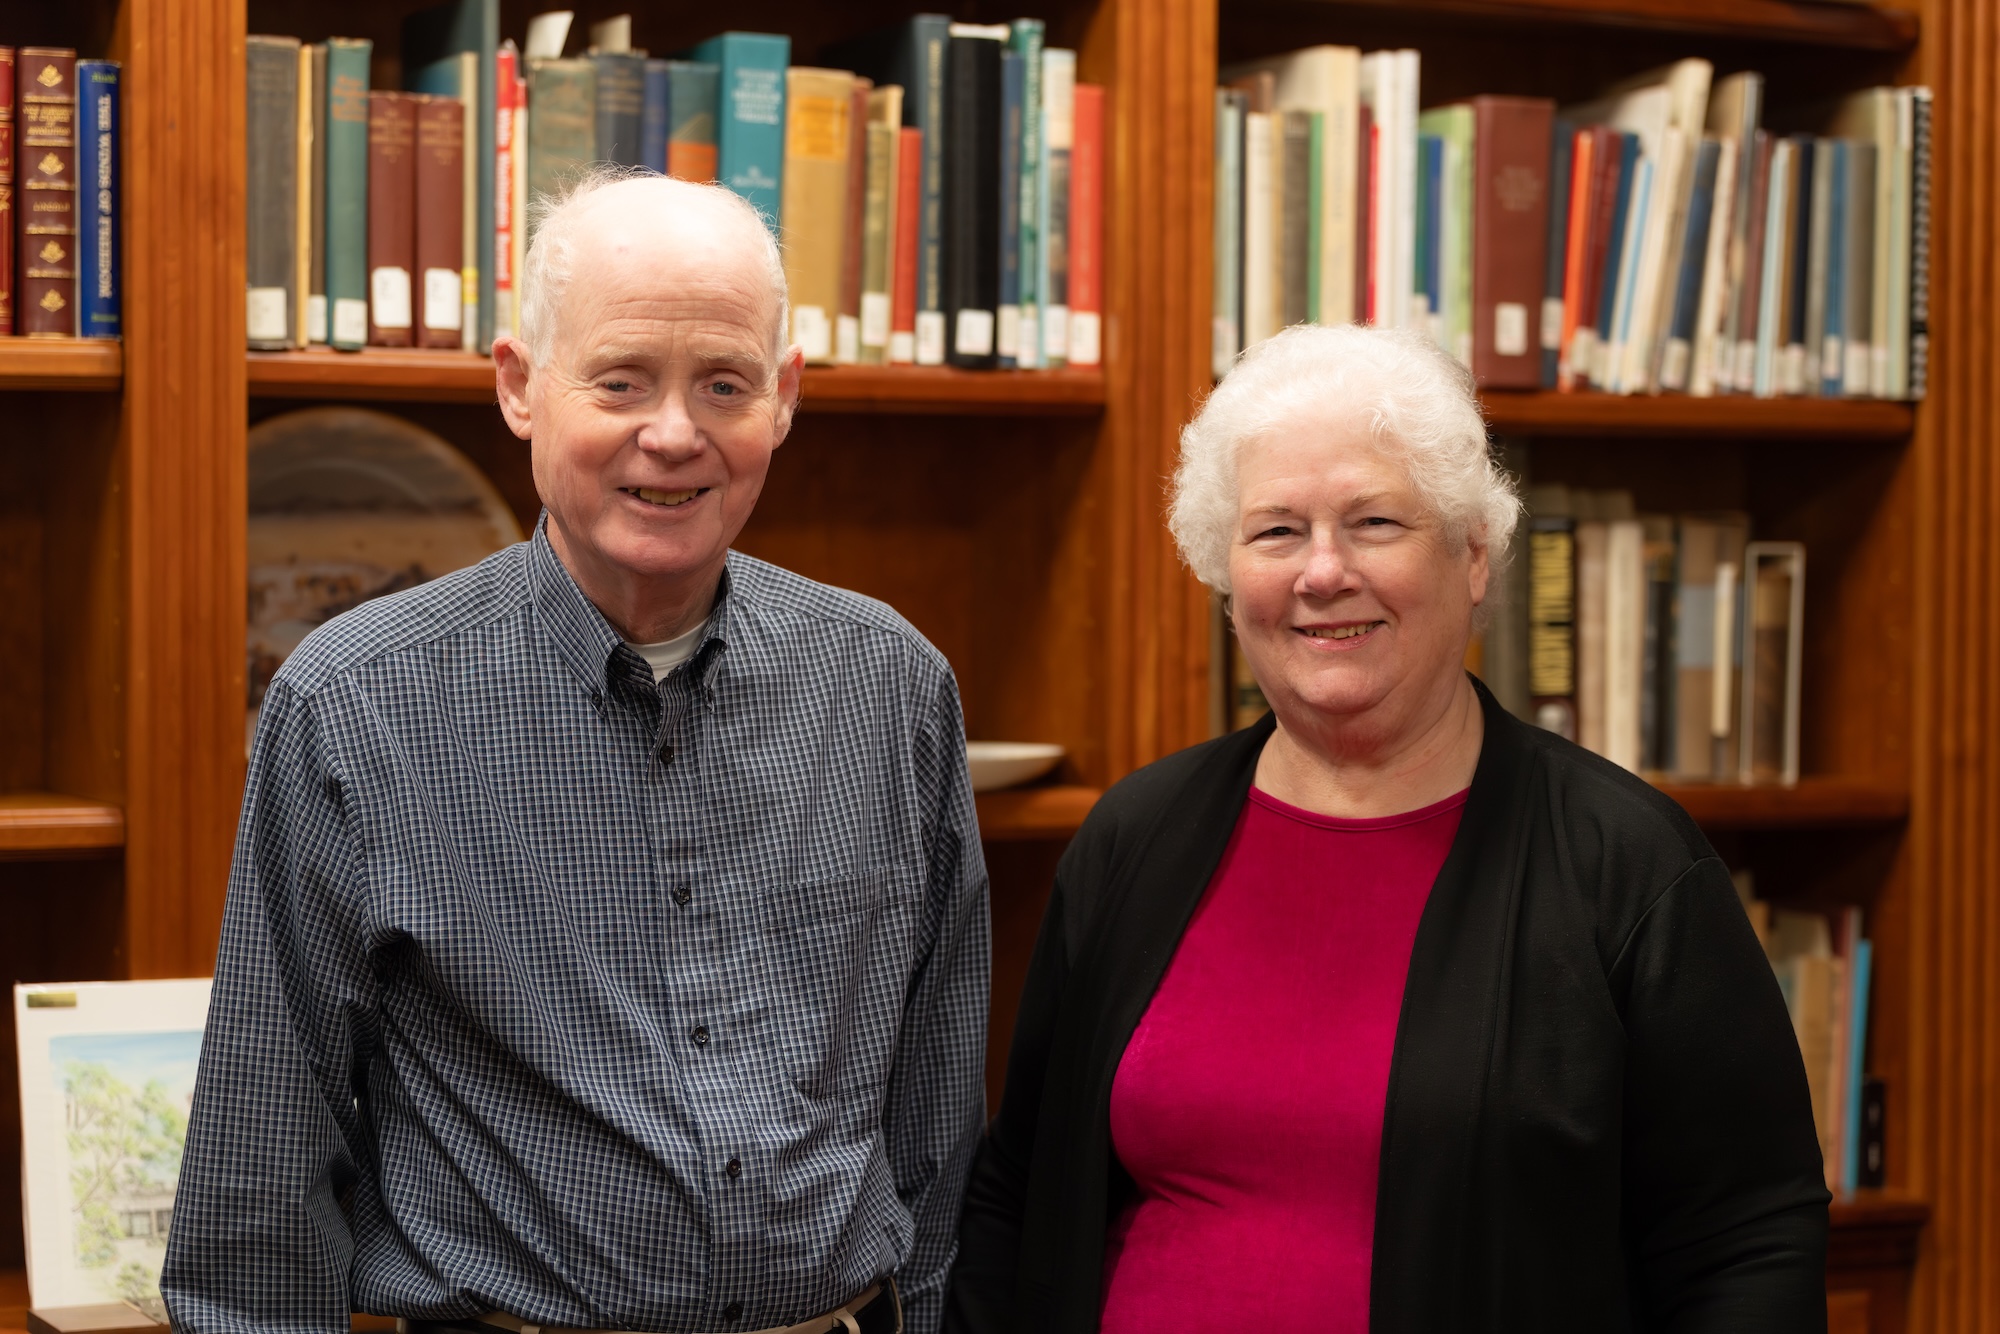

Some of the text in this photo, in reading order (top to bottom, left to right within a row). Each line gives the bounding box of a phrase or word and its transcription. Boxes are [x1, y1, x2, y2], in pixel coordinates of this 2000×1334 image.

[98, 93, 112, 131] THE
[98, 132, 112, 189] WINDS
[98, 189, 112, 215] OF
[496, 150, 512, 229] Washington
[98, 216, 112, 299] FREEDOM
